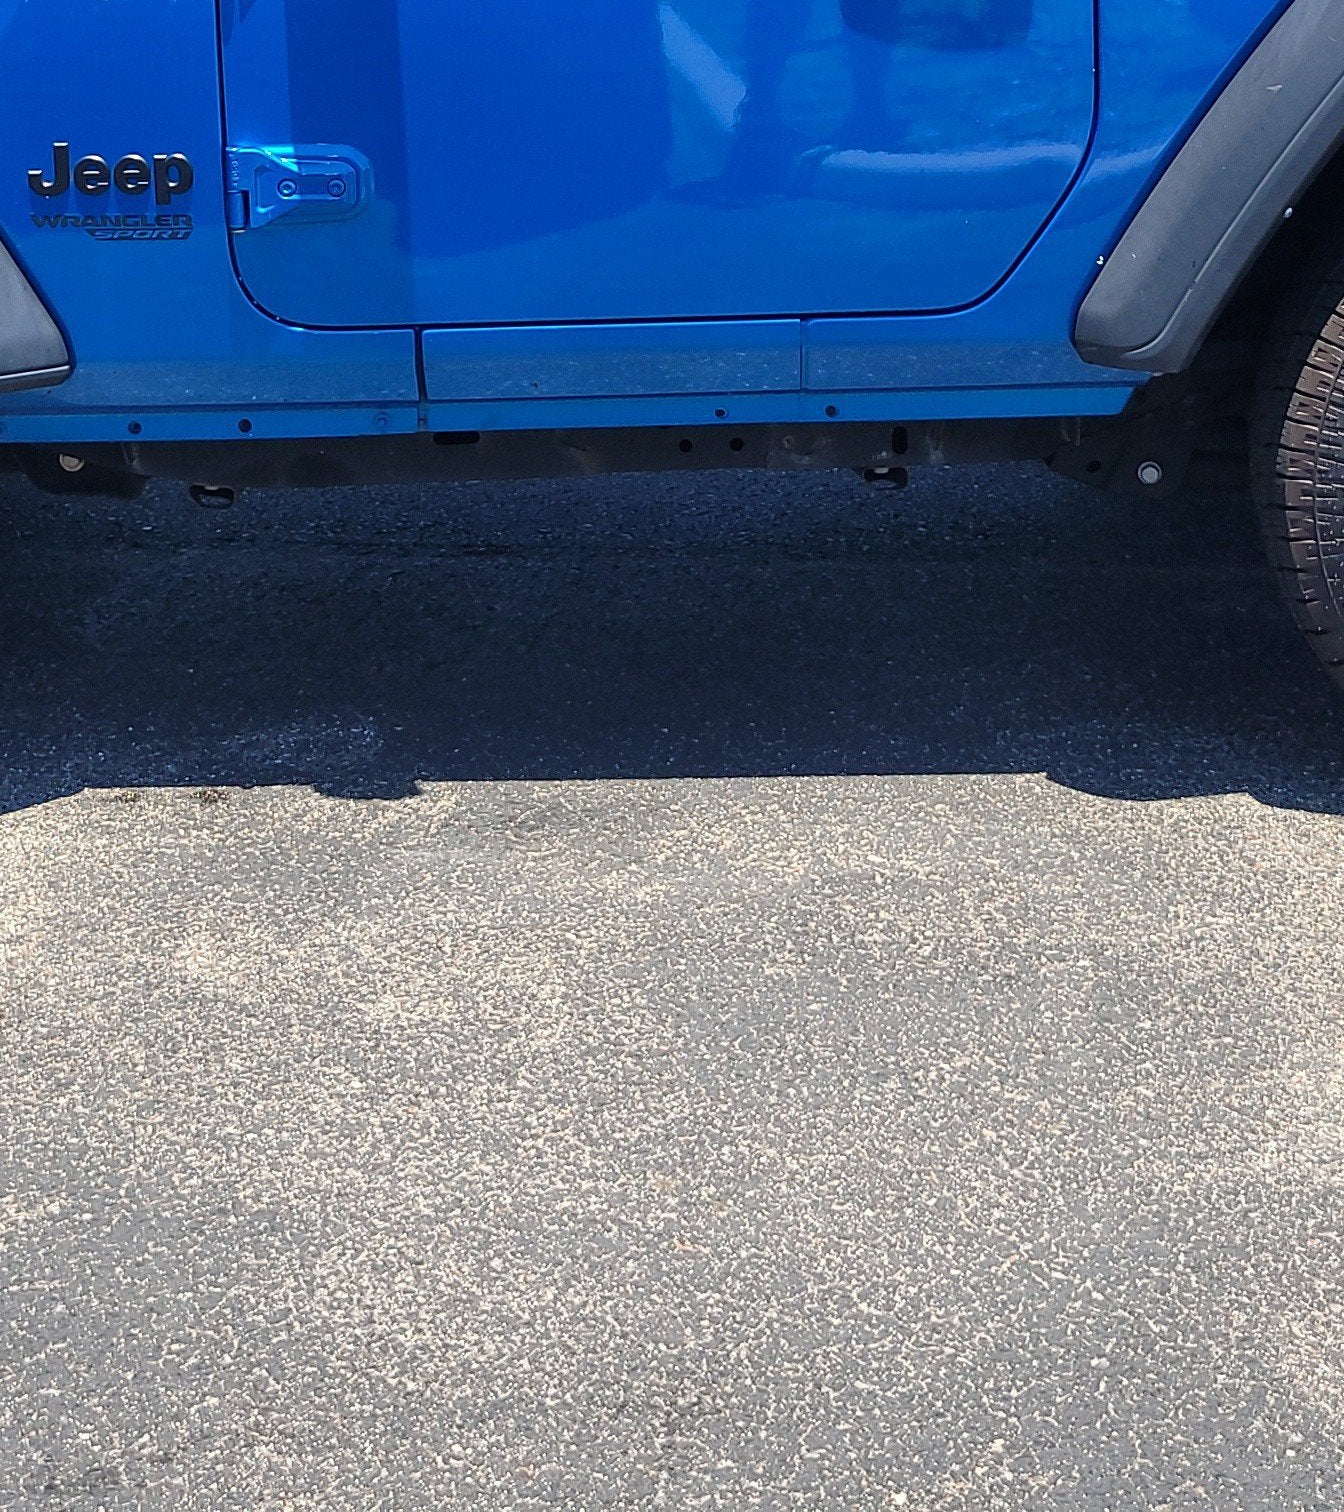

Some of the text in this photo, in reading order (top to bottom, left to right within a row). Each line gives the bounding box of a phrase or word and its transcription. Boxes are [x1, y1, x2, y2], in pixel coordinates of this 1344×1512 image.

[27, 141, 194, 205] Jeep
[28, 213, 193, 228] WRANGLER
[92, 228, 190, 239] SPORT
